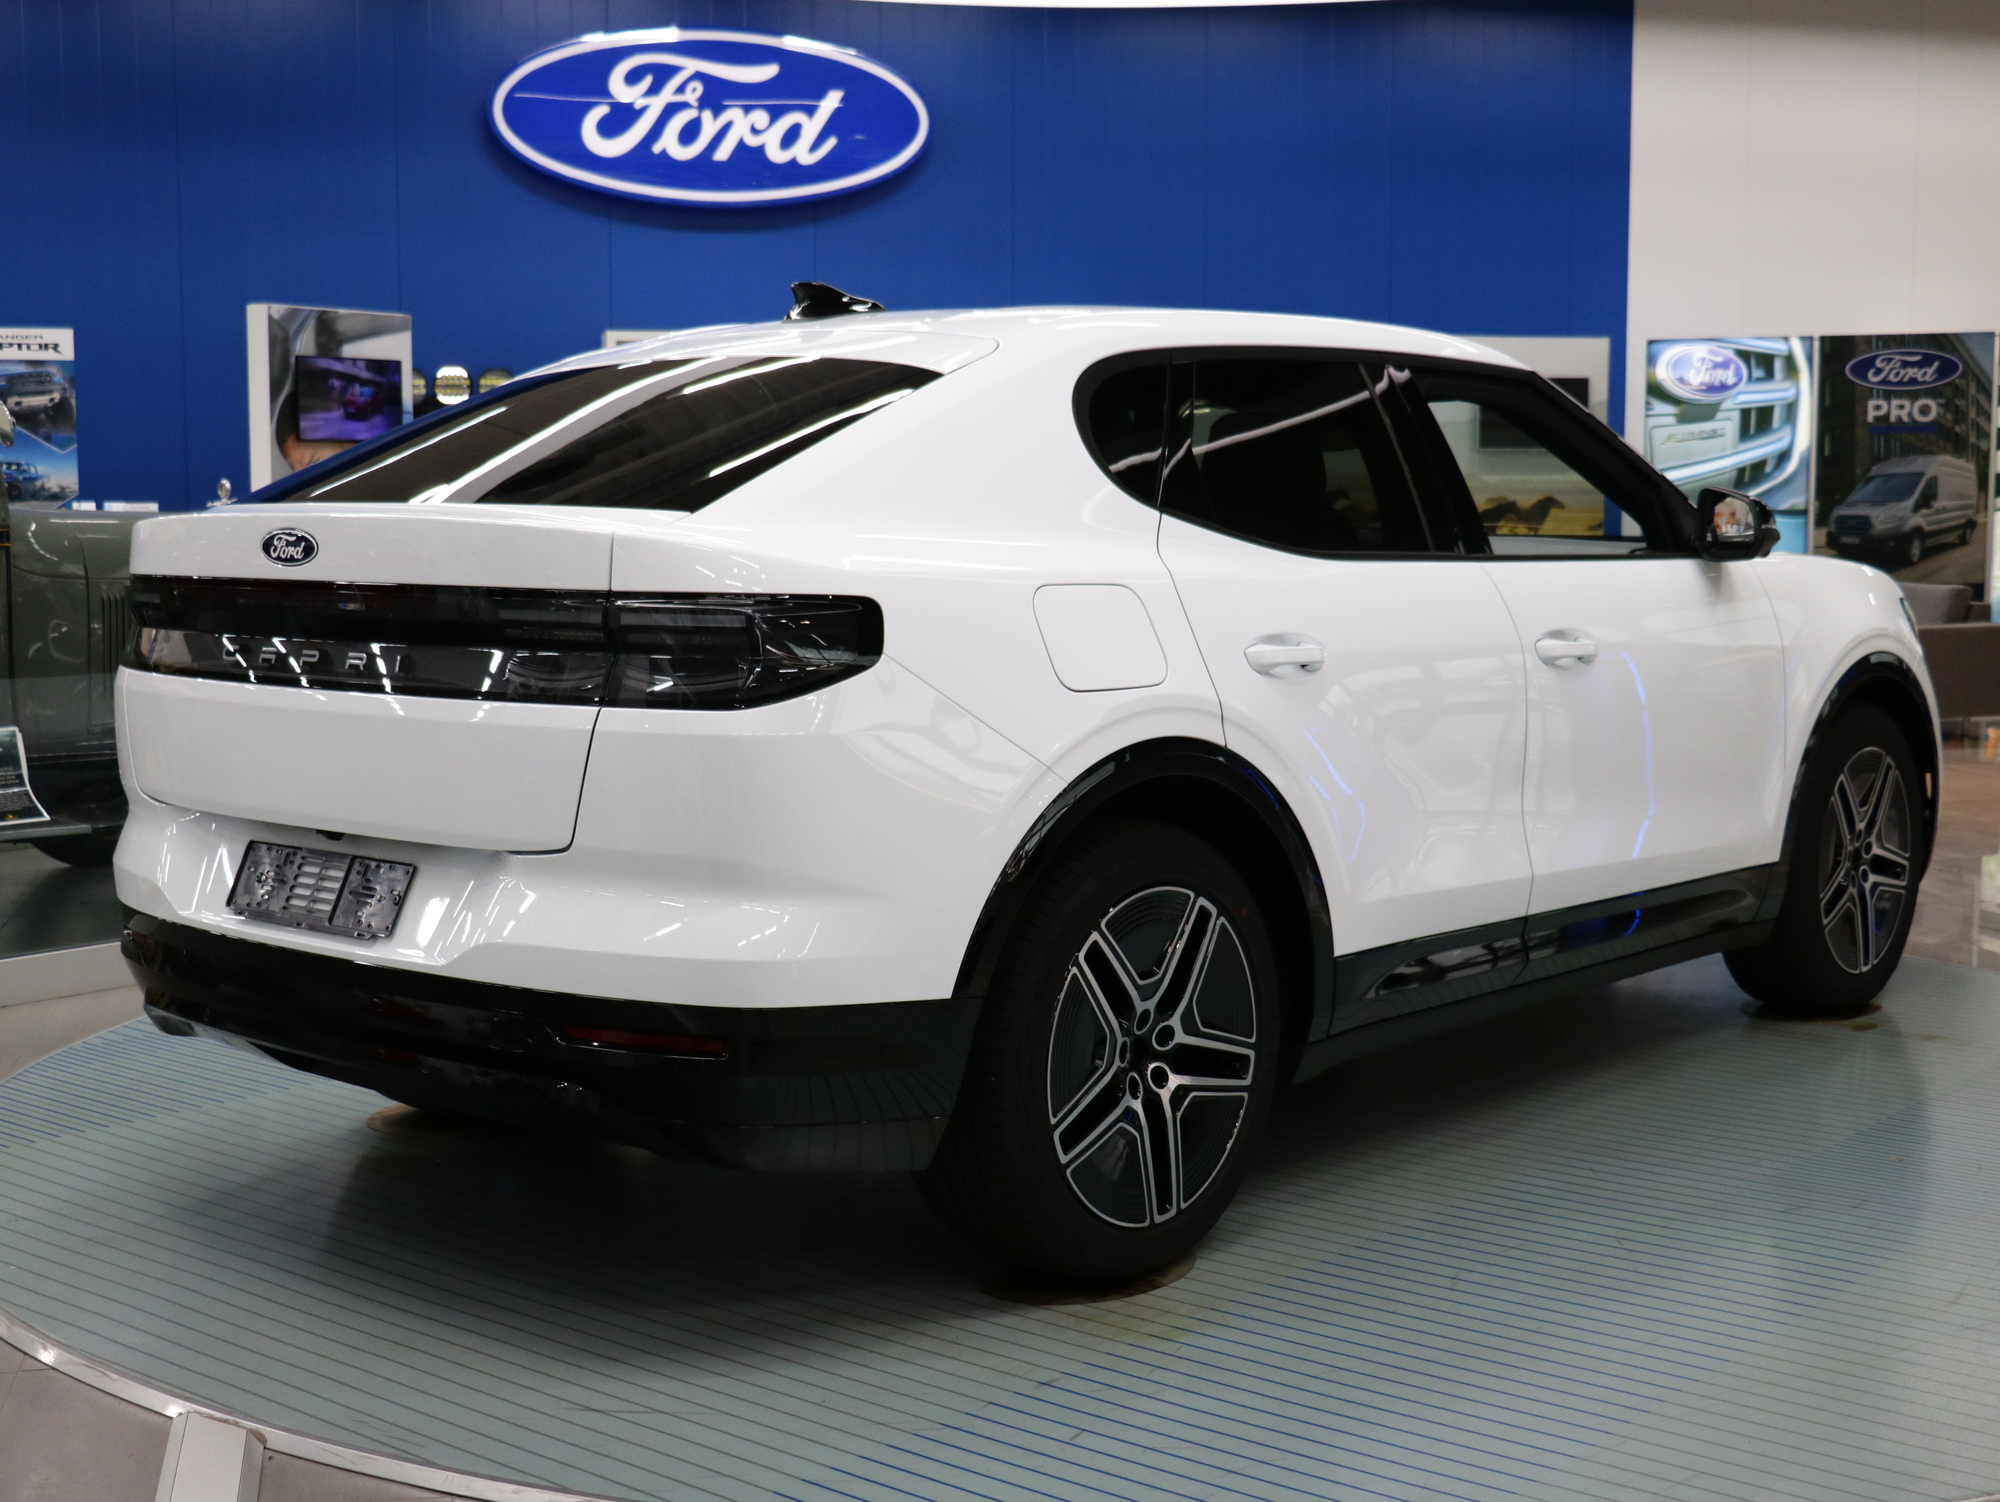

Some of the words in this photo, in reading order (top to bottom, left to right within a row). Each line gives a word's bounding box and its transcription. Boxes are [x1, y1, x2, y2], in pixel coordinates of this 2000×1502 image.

[581, 53, 845, 165] Ford
[0, 343, 64, 356] PTOR
[1688, 352, 1736, 386] Ford
[1867, 354, 1940, 383] Ford
[1867, 398, 1937, 423] PRO
[270, 534, 305, 559] Ford
[222, 645, 401, 673] CAPRI
